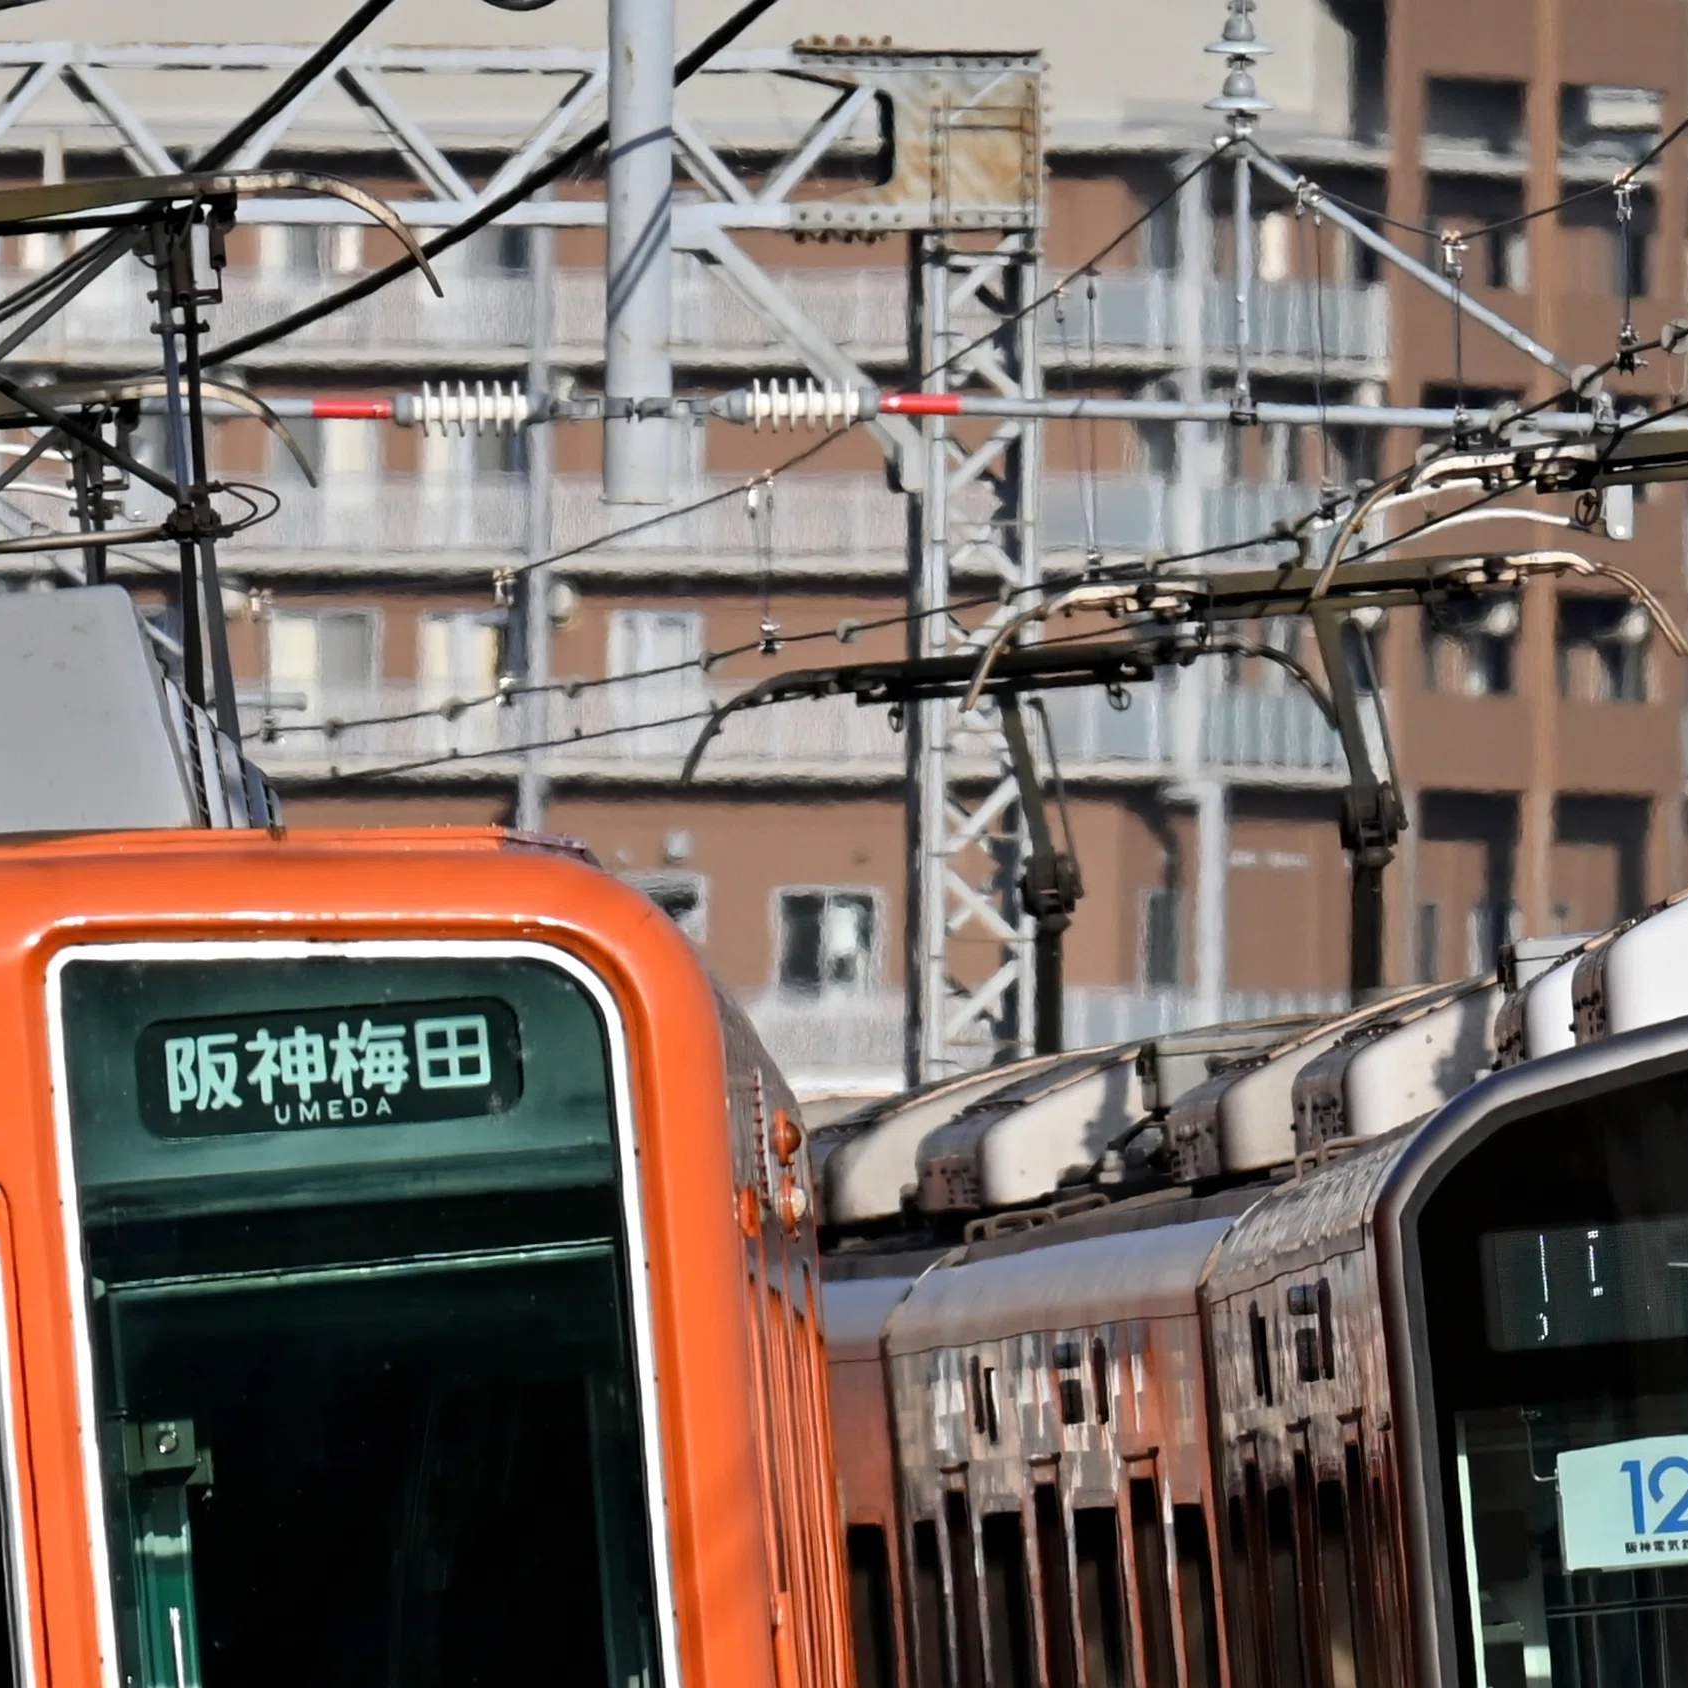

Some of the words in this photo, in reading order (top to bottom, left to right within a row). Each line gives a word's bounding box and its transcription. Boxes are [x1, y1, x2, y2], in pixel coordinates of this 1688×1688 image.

[164, 1014, 492, 1114] 阪神梅田
[274, 1096, 393, 1126] UMEDA
